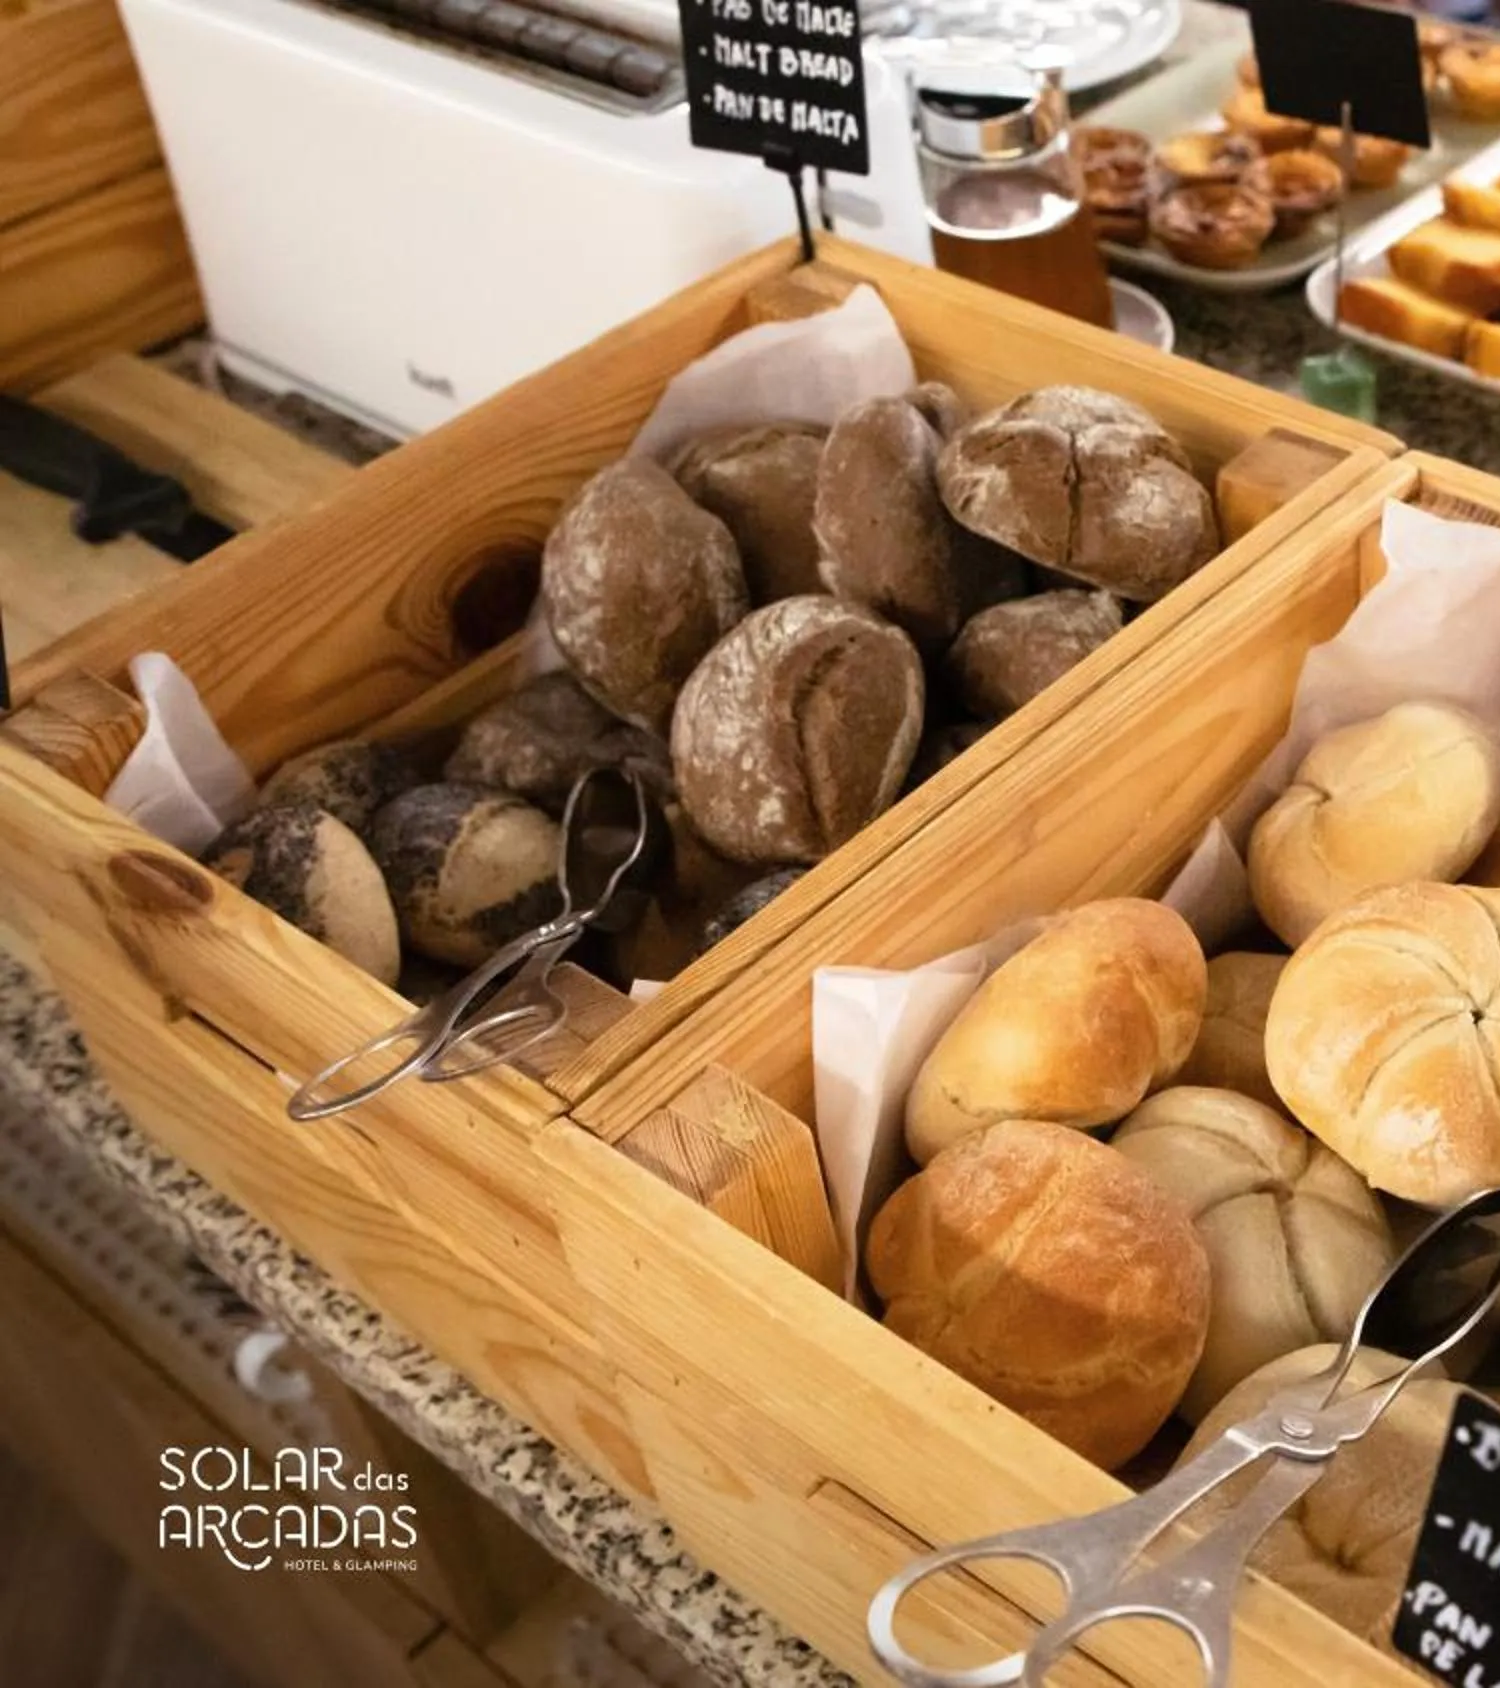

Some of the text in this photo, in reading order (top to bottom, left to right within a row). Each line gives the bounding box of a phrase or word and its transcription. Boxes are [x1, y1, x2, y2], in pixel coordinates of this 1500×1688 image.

[714, 34, 854, 87] MALT BREAD
[713, 83, 859, 145] PAN DE MALTA
[1412, 1581, 1492, 1649] PAN
